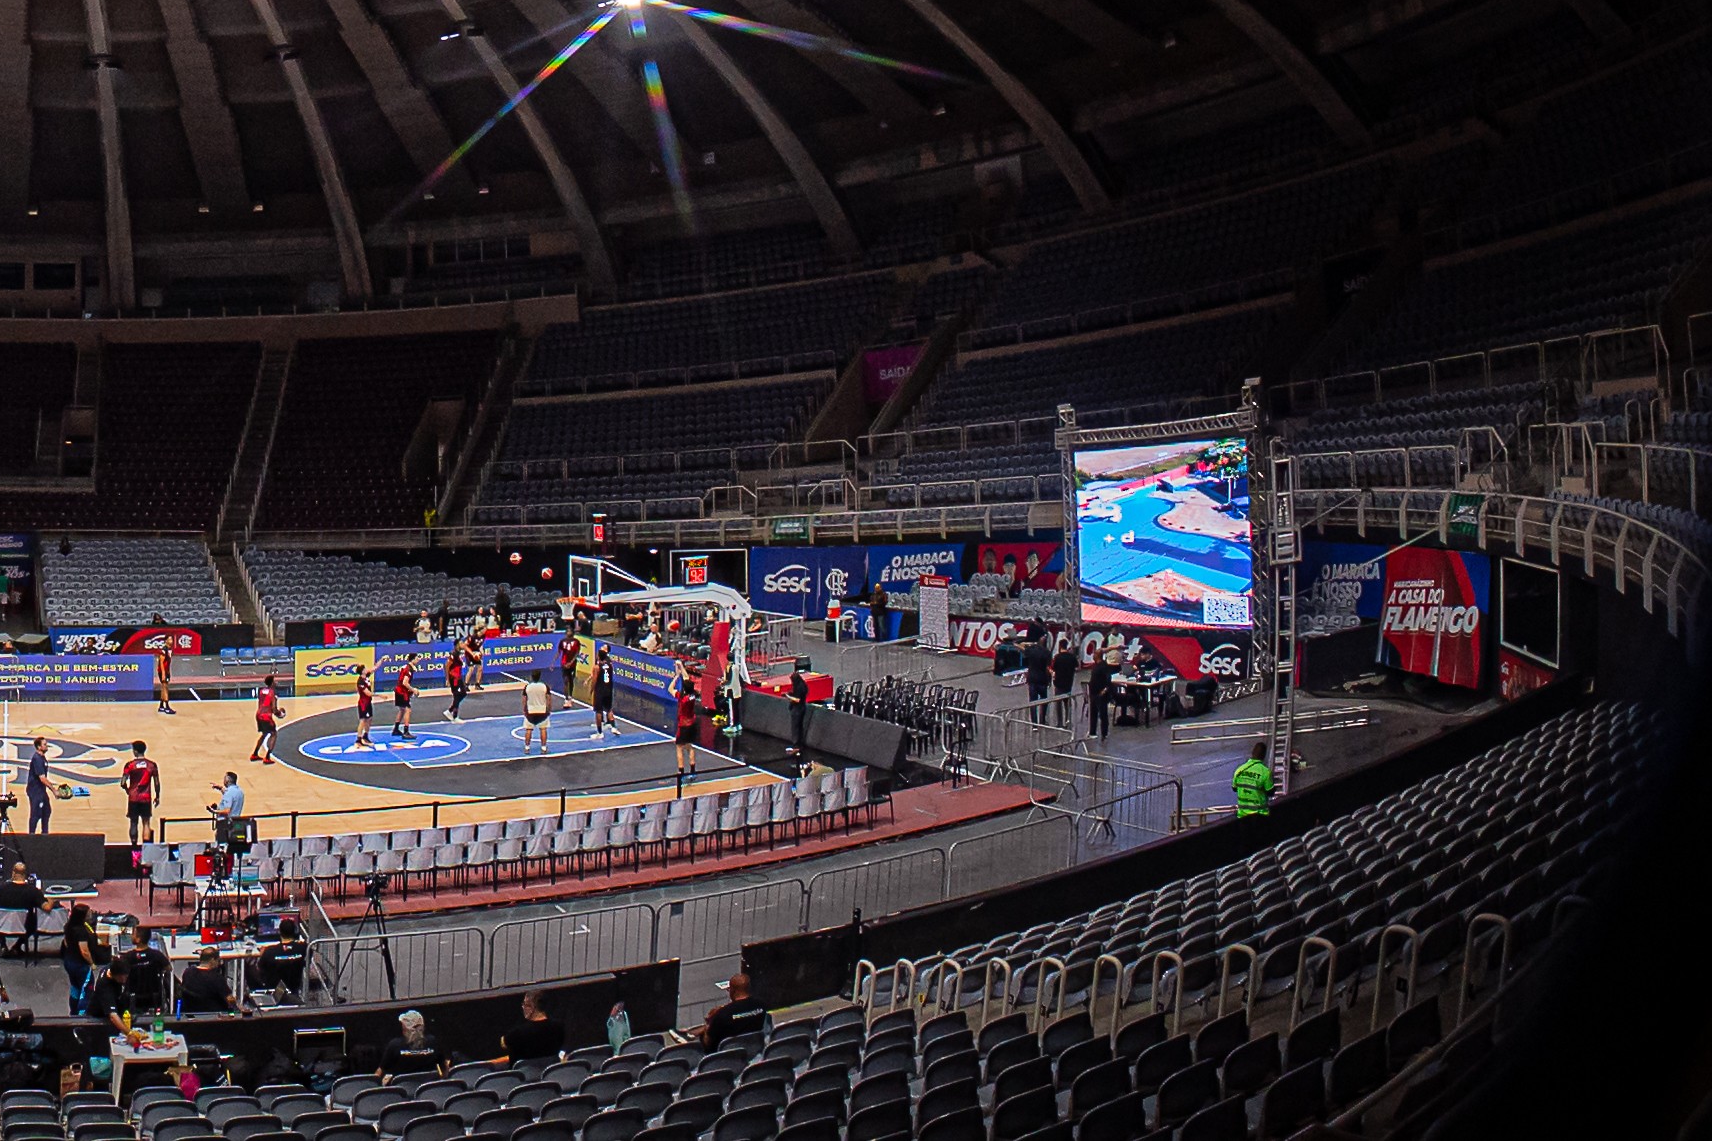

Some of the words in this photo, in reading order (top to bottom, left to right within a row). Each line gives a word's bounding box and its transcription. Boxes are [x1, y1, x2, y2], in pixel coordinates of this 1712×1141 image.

[892, 555, 901, 567] O
[903, 551, 955, 565] MARACA
[763, 569, 811, 593] Sesc
[880, 566, 890, 582] É
[889, 565, 936, 581] NOSSO
[1388, 589, 1396, 604] A
[1398, 588, 1426, 604] CASA
[1383, 606, 1479, 634] FLAMENGO
[494, 642, 554, 655] BEM-ESTAR
[8, 663, 51, 672] MARCA
[54, 664, 70, 672] DE
[73, 664, 139, 672] BEM-ESTAR
[486, 655, 533, 667] JANEIRO
[1199, 650, 1240, 676] Sesc
[22, 675, 43, 684] RIO
[45, 675, 62, 684] DE
[64, 675, 117, 684] JANEIRO
[318, 739, 451, 755] CAIXA
